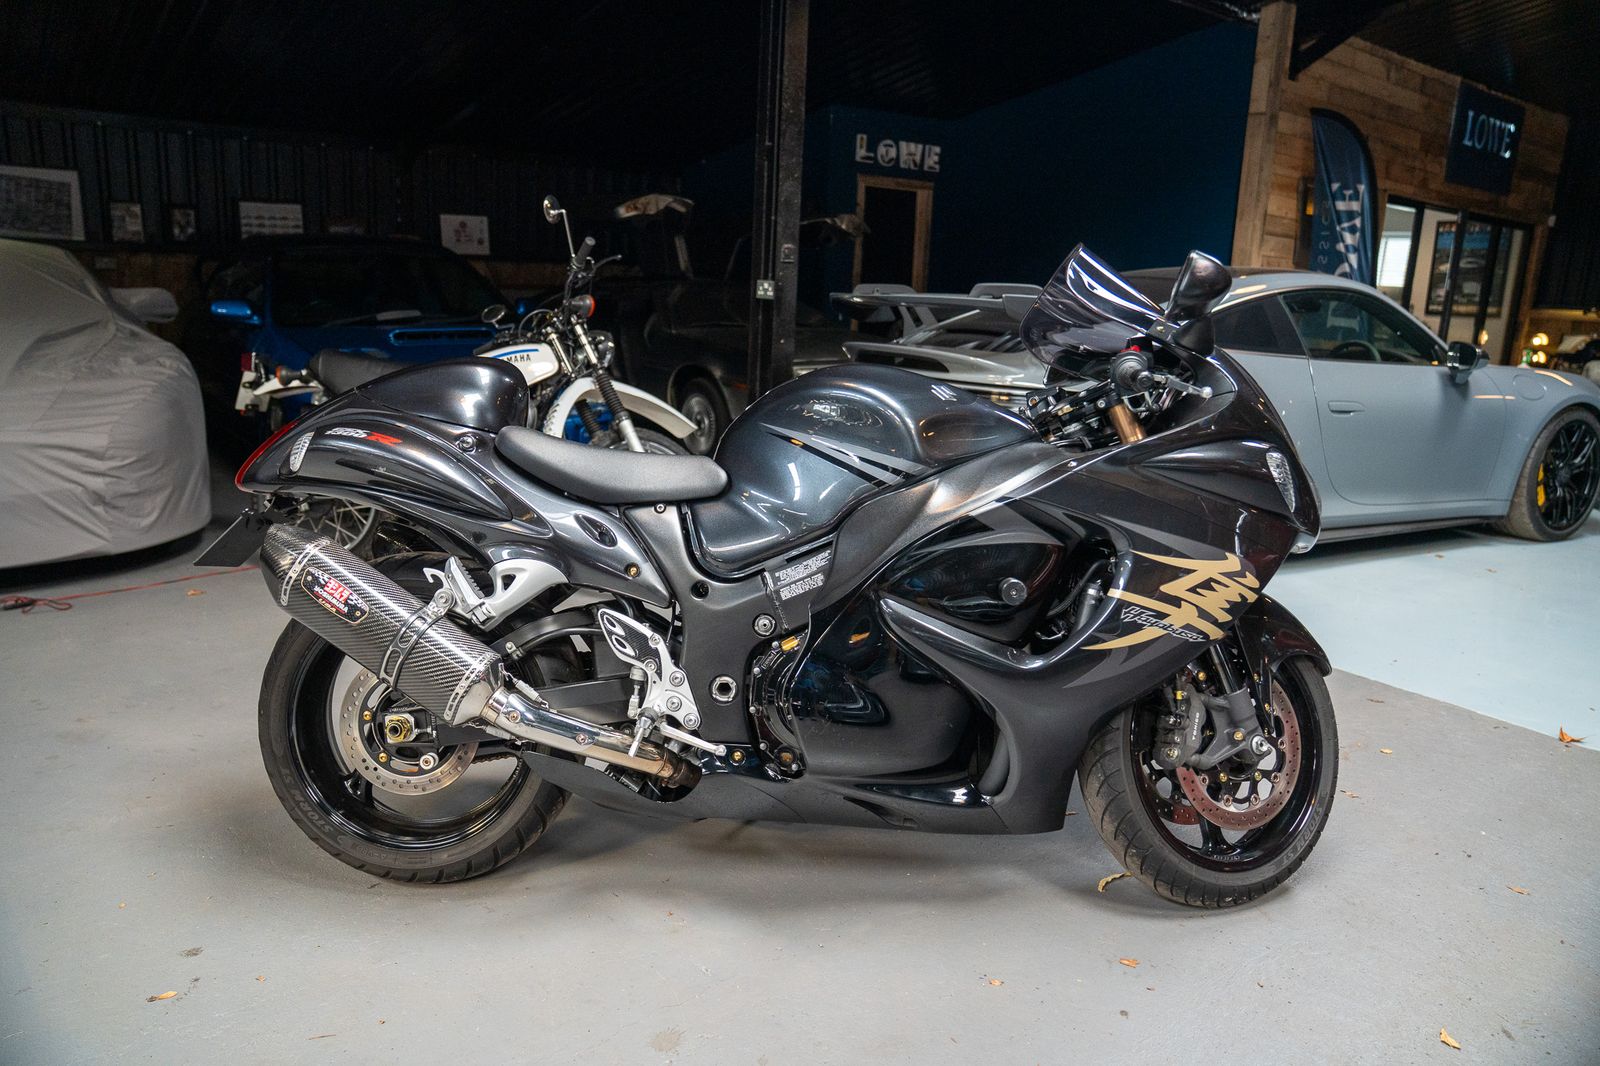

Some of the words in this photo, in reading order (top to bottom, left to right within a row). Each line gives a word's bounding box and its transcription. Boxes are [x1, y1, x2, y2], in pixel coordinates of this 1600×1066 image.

[855, 133, 942, 173] LOWE
[1462, 109, 1517, 159] LOWE
[503, 353, 532, 363] MAHA
